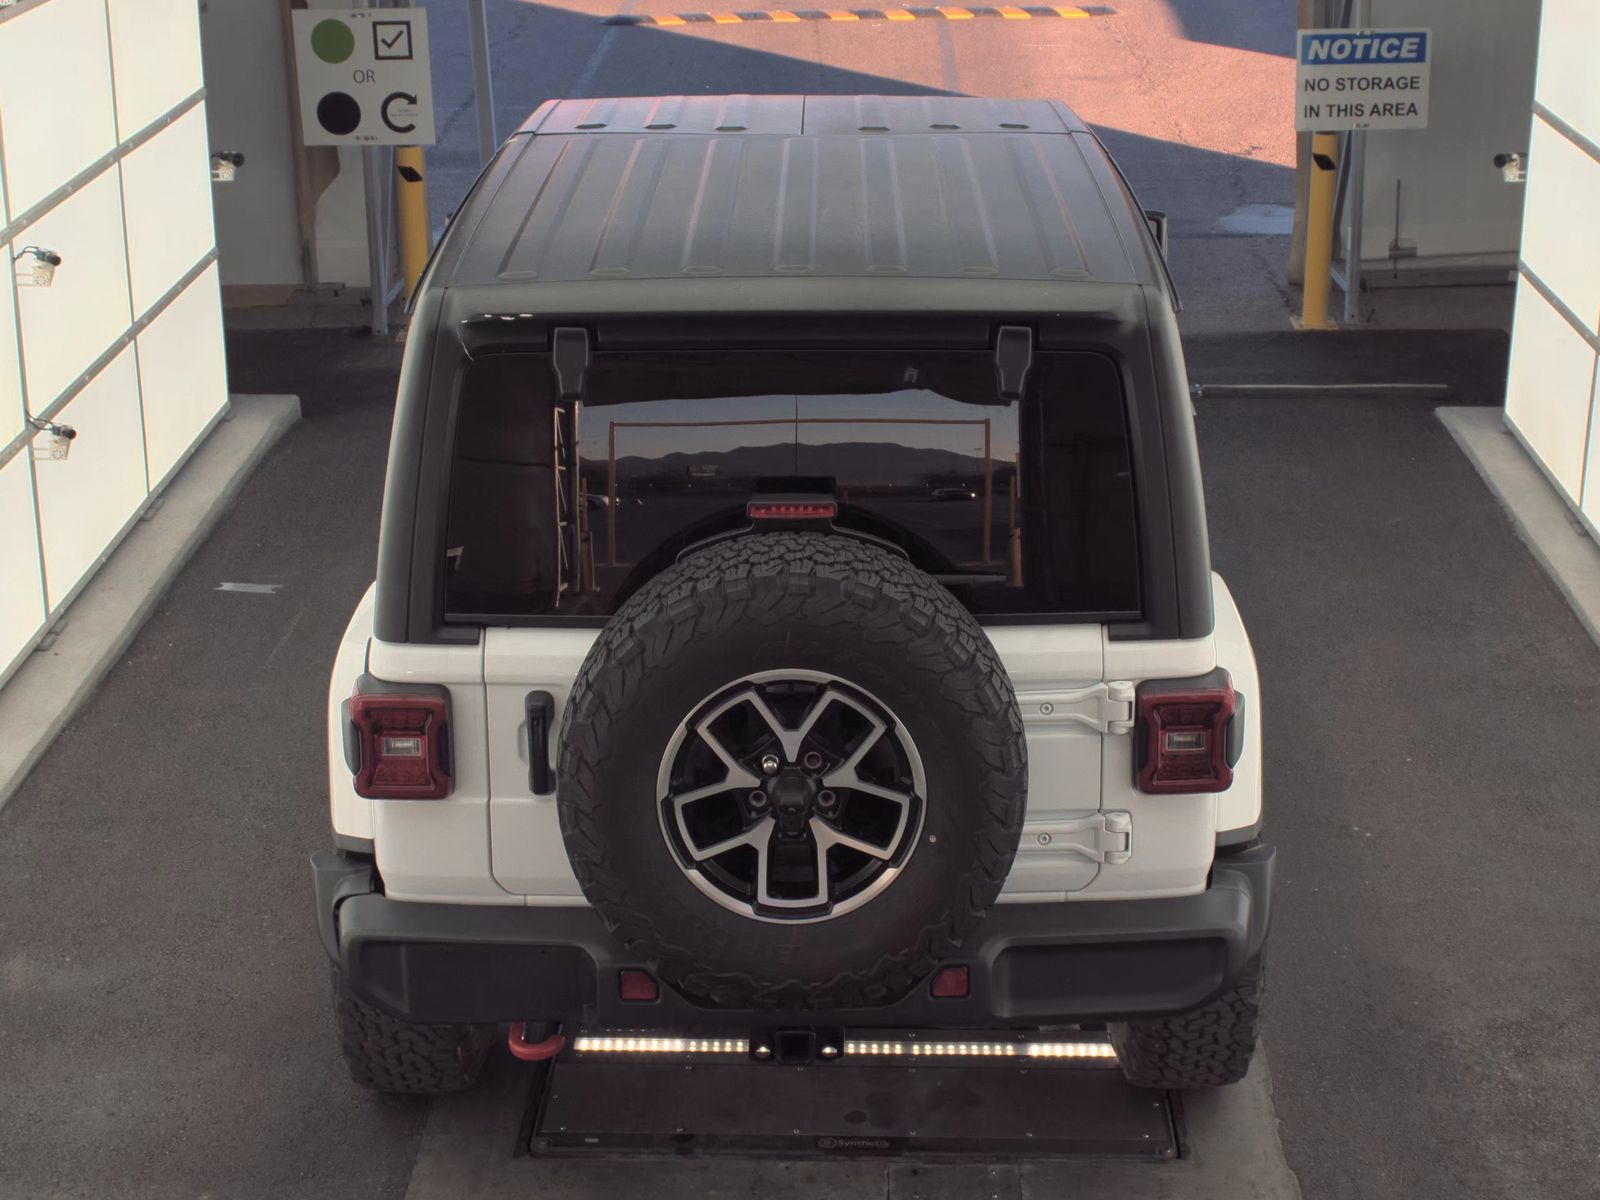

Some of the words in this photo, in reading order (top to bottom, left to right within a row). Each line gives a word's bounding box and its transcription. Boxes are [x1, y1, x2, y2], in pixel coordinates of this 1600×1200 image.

[1308, 38, 1420, 60] NOTICE
[353, 69, 376, 84] OR
[1304, 78, 1329, 92] NO
[1335, 76, 1420, 91] STORAGE
[1304, 105, 1320, 118] IN
[1325, 103, 1365, 118] THIS
[1369, 102, 1418, 117] AREA
